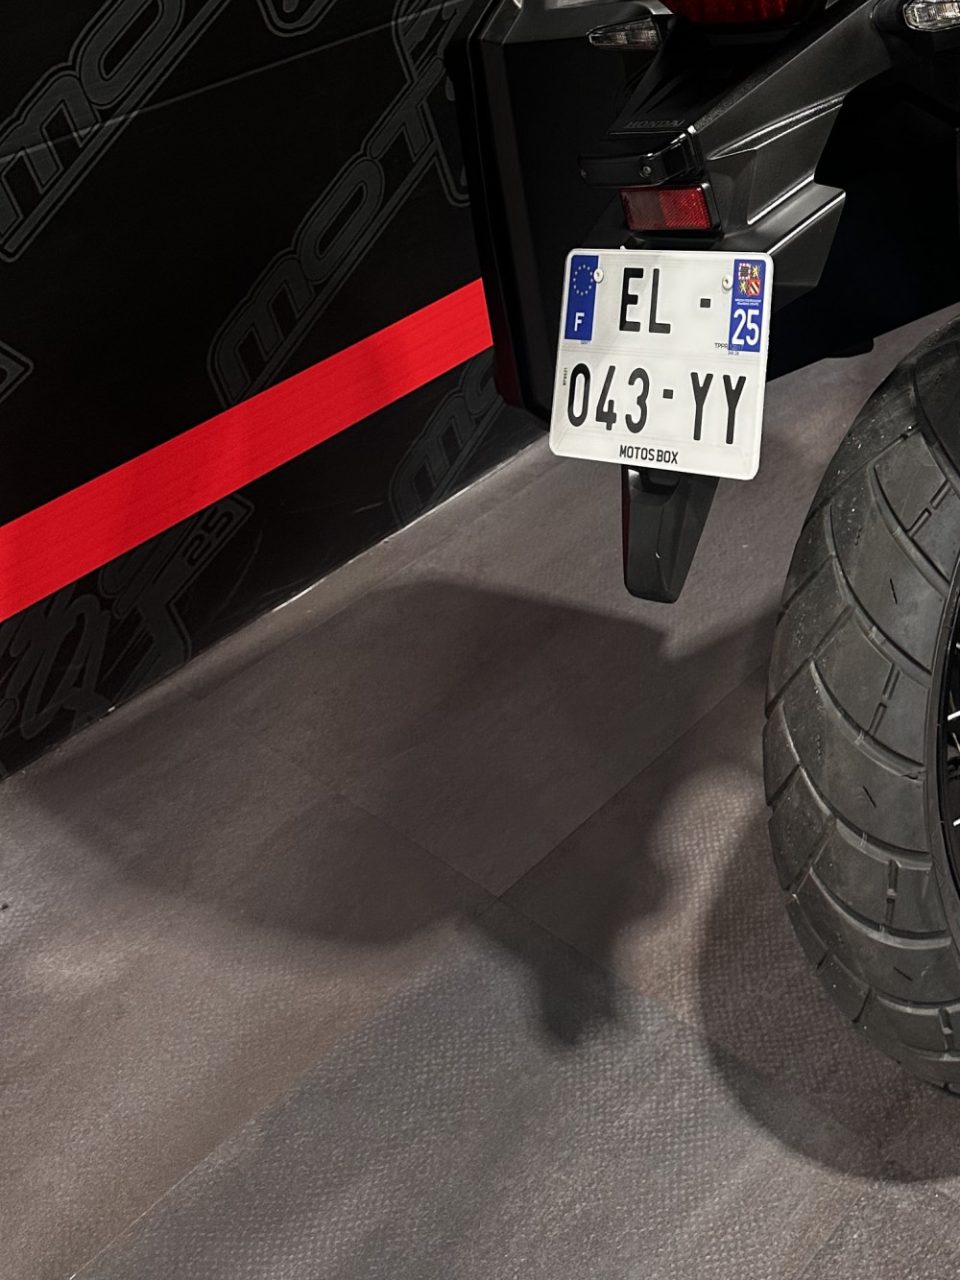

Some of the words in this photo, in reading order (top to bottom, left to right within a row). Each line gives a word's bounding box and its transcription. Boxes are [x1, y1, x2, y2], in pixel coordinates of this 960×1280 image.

[573, 312, 585, 332] F
[731, 308, 760, 346] 25
[656, 449, 679, 465] BOX
